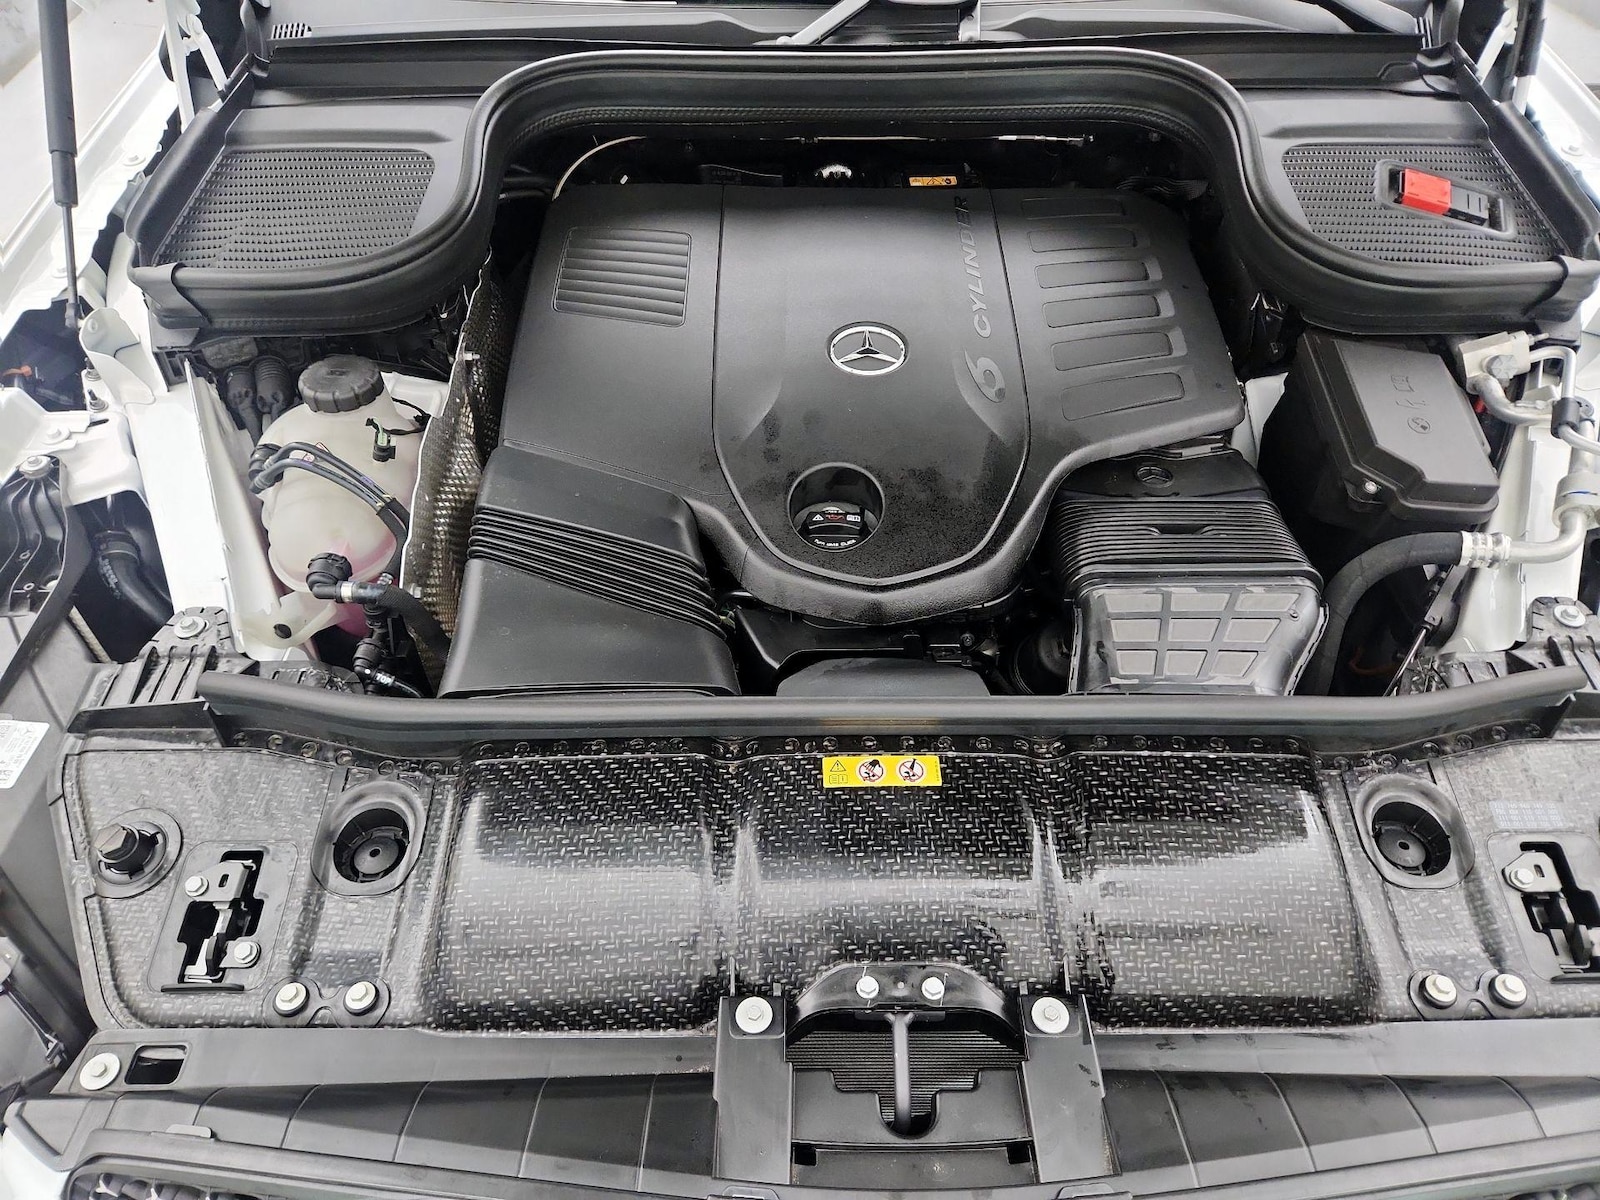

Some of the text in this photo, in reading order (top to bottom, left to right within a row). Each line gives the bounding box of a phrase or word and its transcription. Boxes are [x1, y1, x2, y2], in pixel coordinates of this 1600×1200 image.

[954, 196, 1005, 403] 6 CYLINDER
[376, 673, 391, 685] TOP
